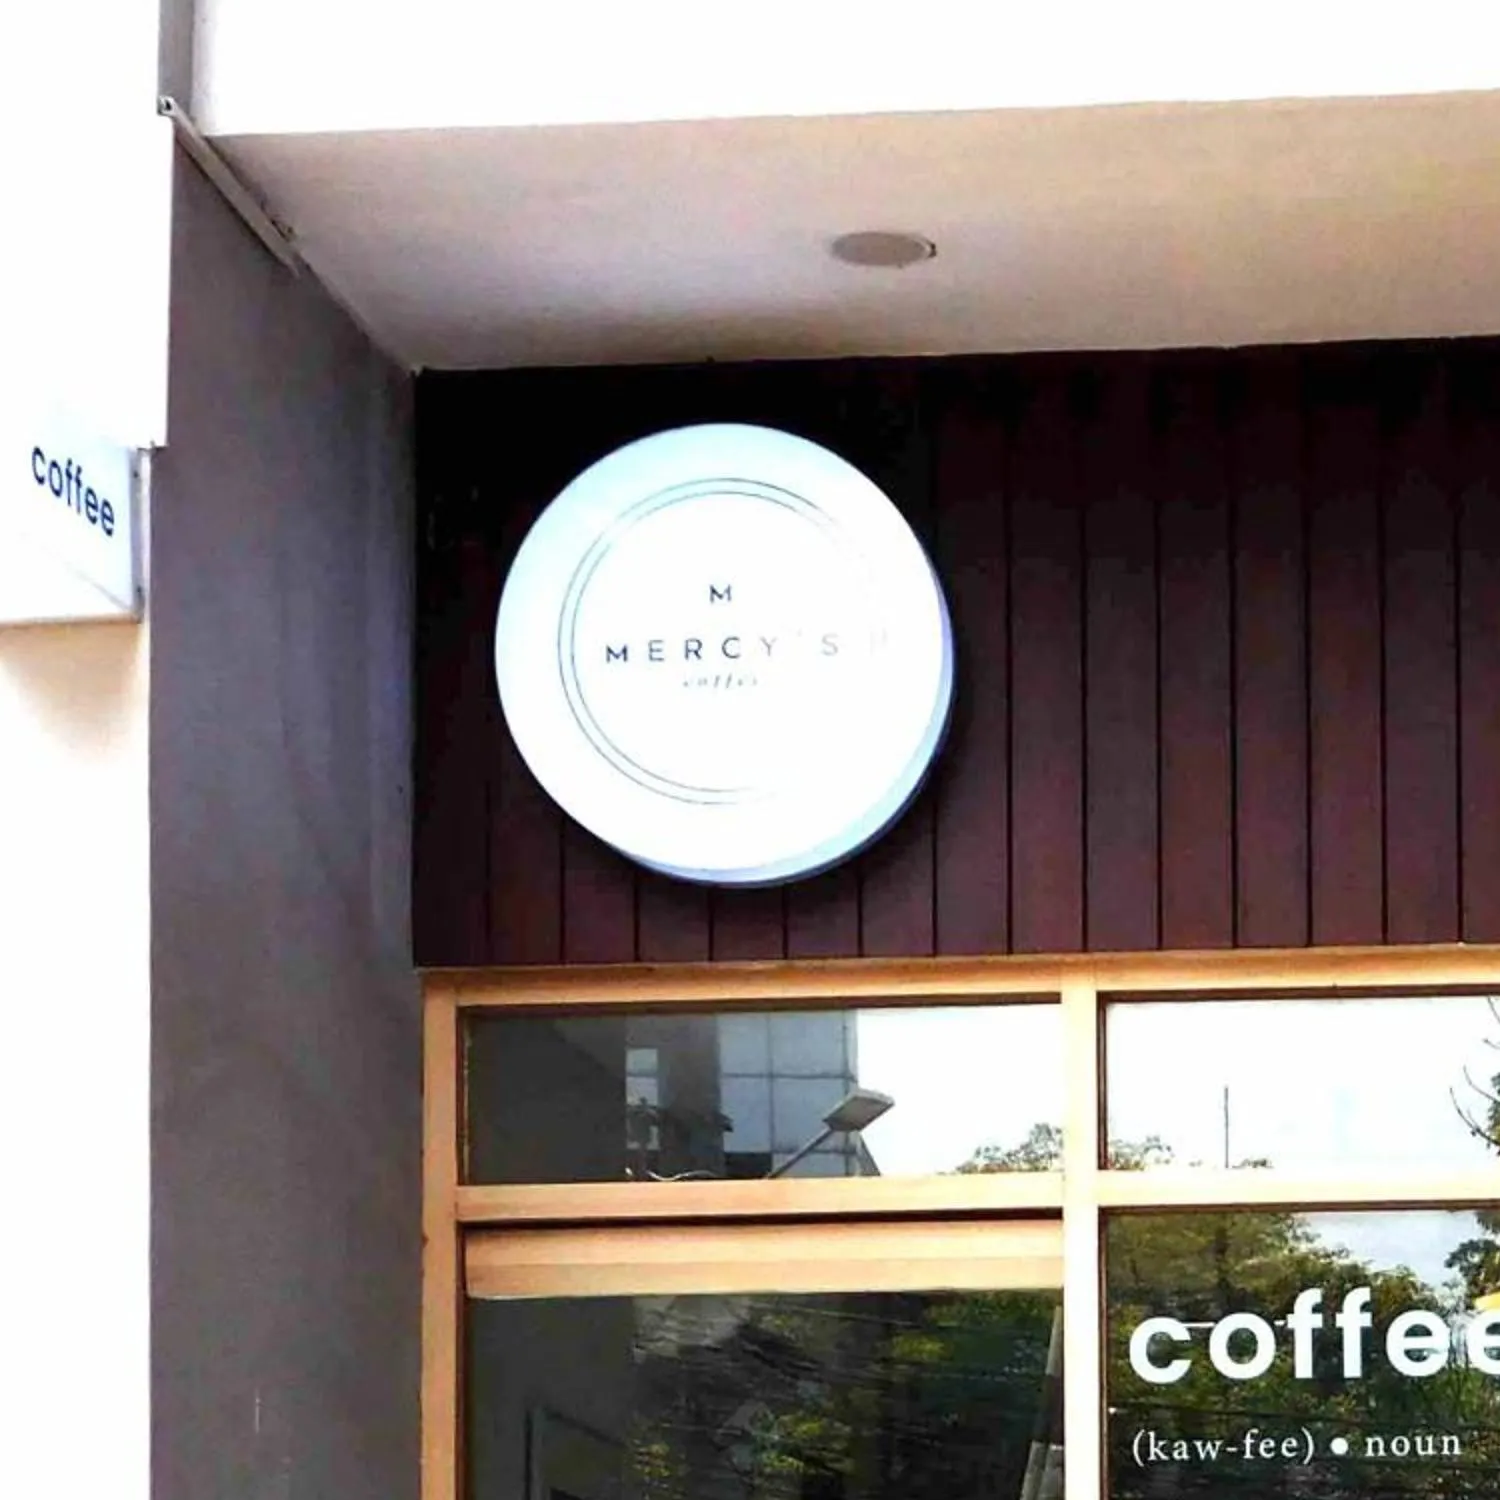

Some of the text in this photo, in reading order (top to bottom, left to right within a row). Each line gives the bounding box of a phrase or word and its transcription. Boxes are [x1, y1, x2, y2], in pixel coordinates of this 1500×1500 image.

[31, 446, 115, 537] coffee
[1131, 1428, 1463, 1467] (kaw-fee) noun
